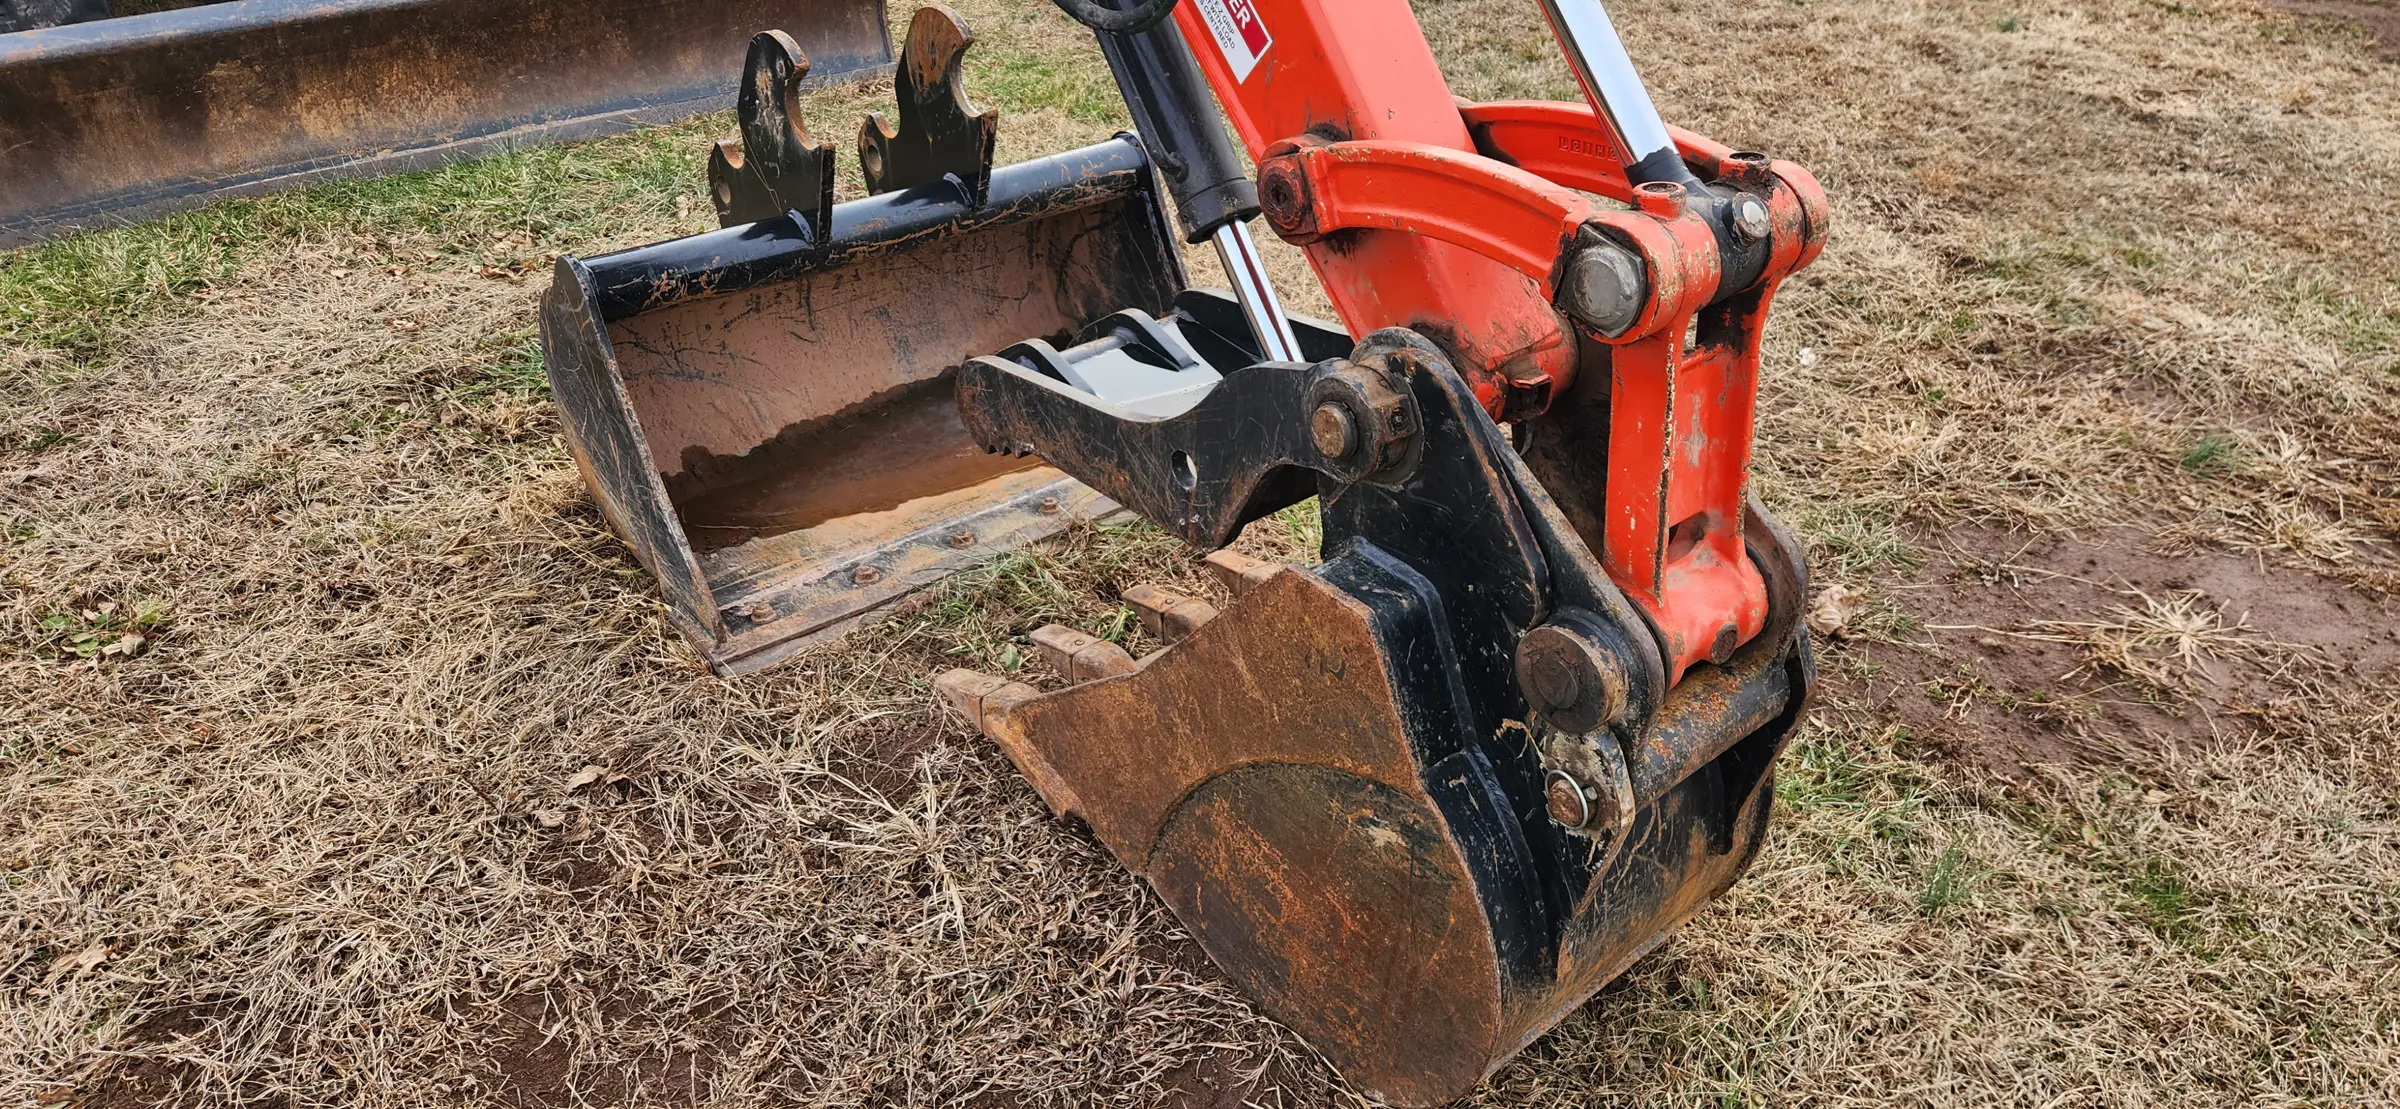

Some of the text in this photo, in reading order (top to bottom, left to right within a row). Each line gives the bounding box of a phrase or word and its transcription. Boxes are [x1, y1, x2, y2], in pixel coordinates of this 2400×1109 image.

[1203, 5, 1229, 49] CENTERED
[1210, 4, 1223, 26] WITH
[1222, 25, 1236, 49] LOAD
[1222, 15, 1235, 35] GRIP
